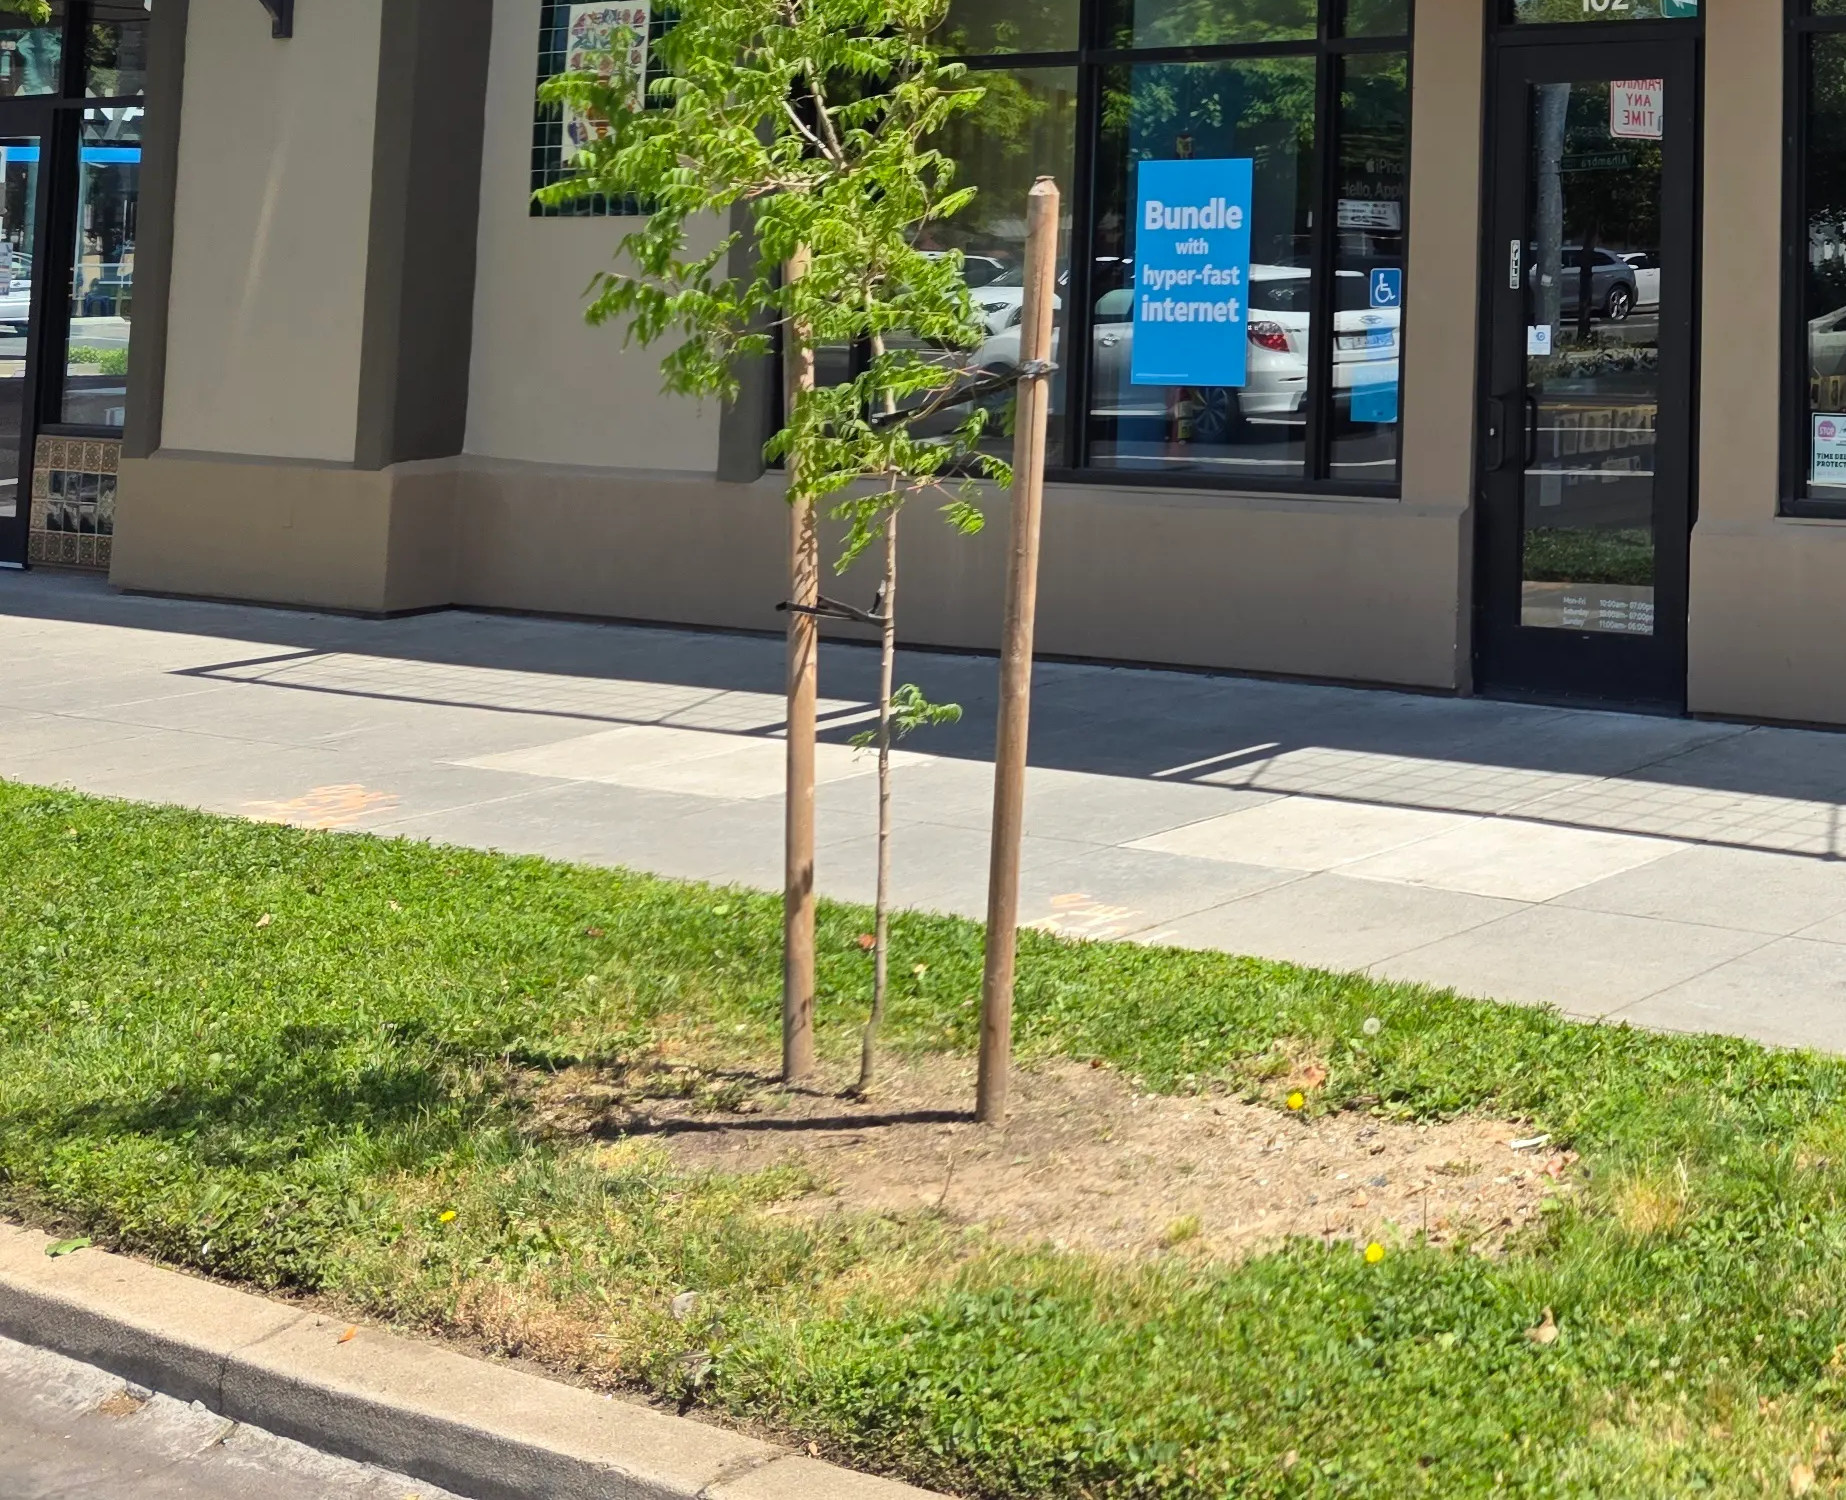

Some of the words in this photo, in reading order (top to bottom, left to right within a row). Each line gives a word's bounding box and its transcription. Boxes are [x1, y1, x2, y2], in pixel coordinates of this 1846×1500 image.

[1144, 197, 1243, 230] Bundle
[1175, 237, 1209, 255] with
[1142, 263, 1240, 290] hyper-fast
[1141, 293, 1240, 322] internet
[1819, 427, 1835, 436] STOP
[1816, 452, 1833, 460] TIME
[1563, 596, 1587, 605] Mon-Fri
